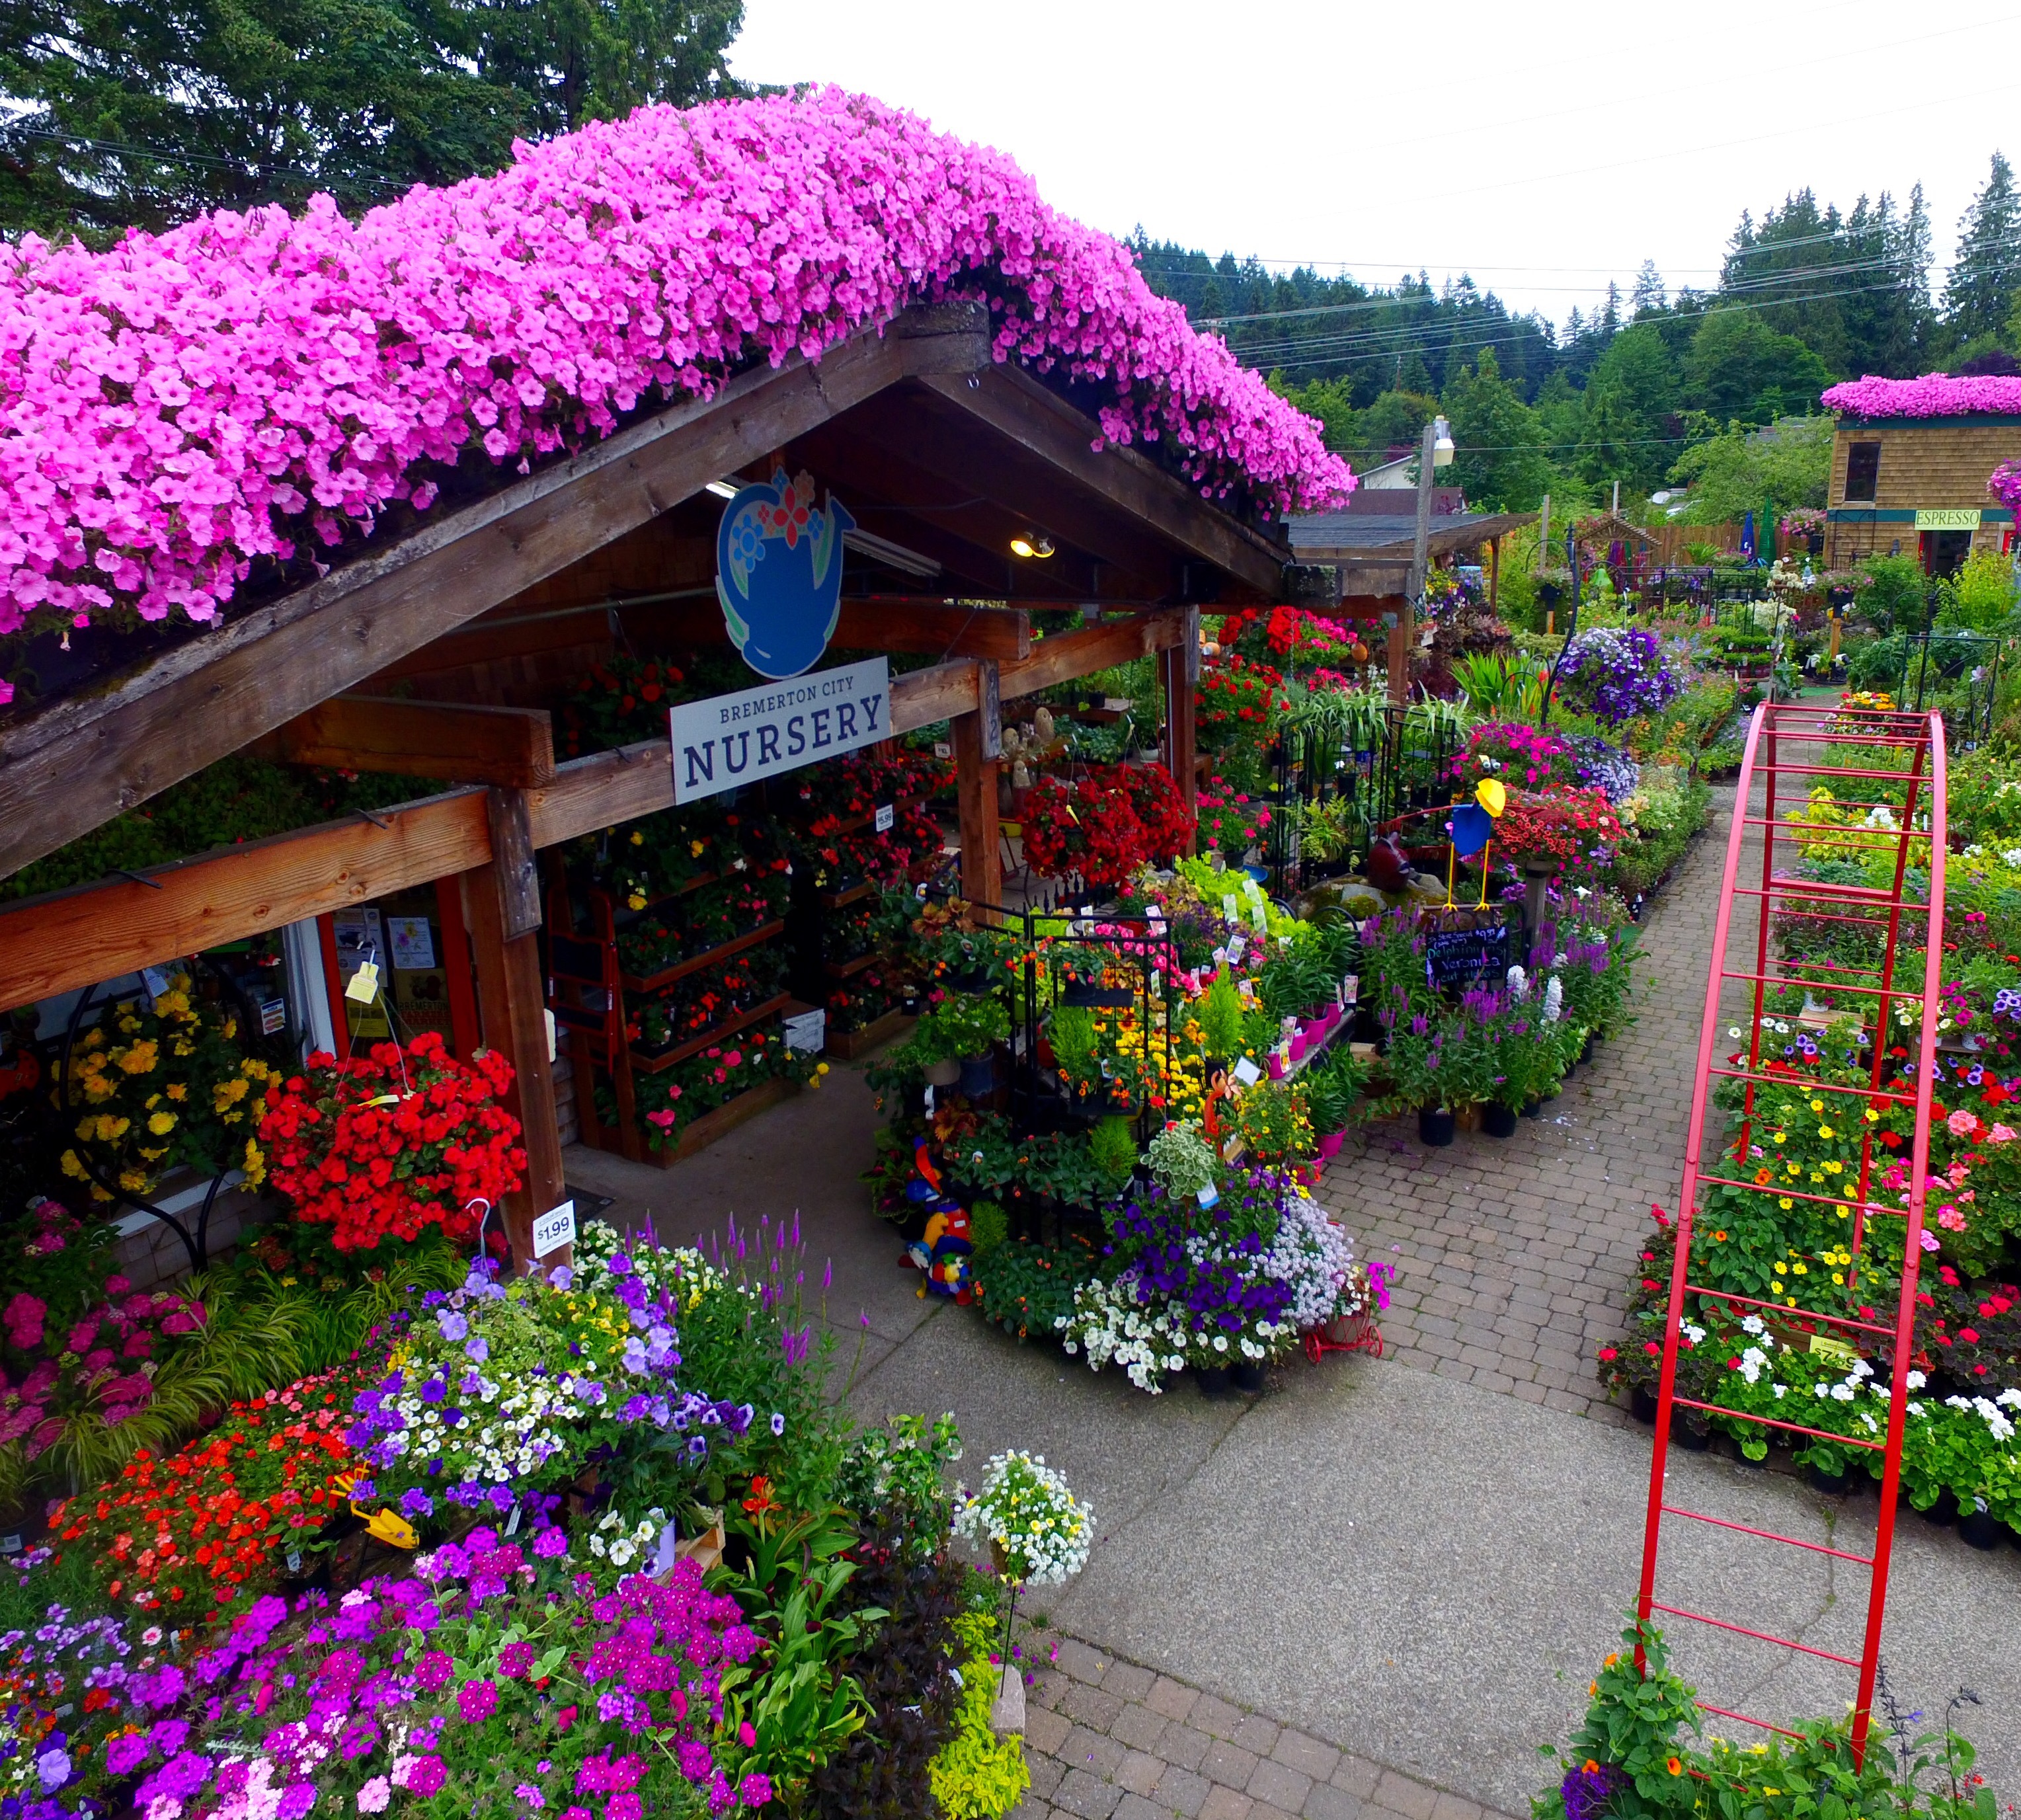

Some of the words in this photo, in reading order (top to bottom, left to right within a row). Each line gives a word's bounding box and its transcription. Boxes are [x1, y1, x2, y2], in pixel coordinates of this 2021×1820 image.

[1916, 510, 1979, 526] ESPRESSO
[720, 685, 817, 724] BREMERTON
[822, 676, 854, 696] CITY
[684, 693, 883, 788] NURSERY
[537, 1216, 569, 1240] $1.99
